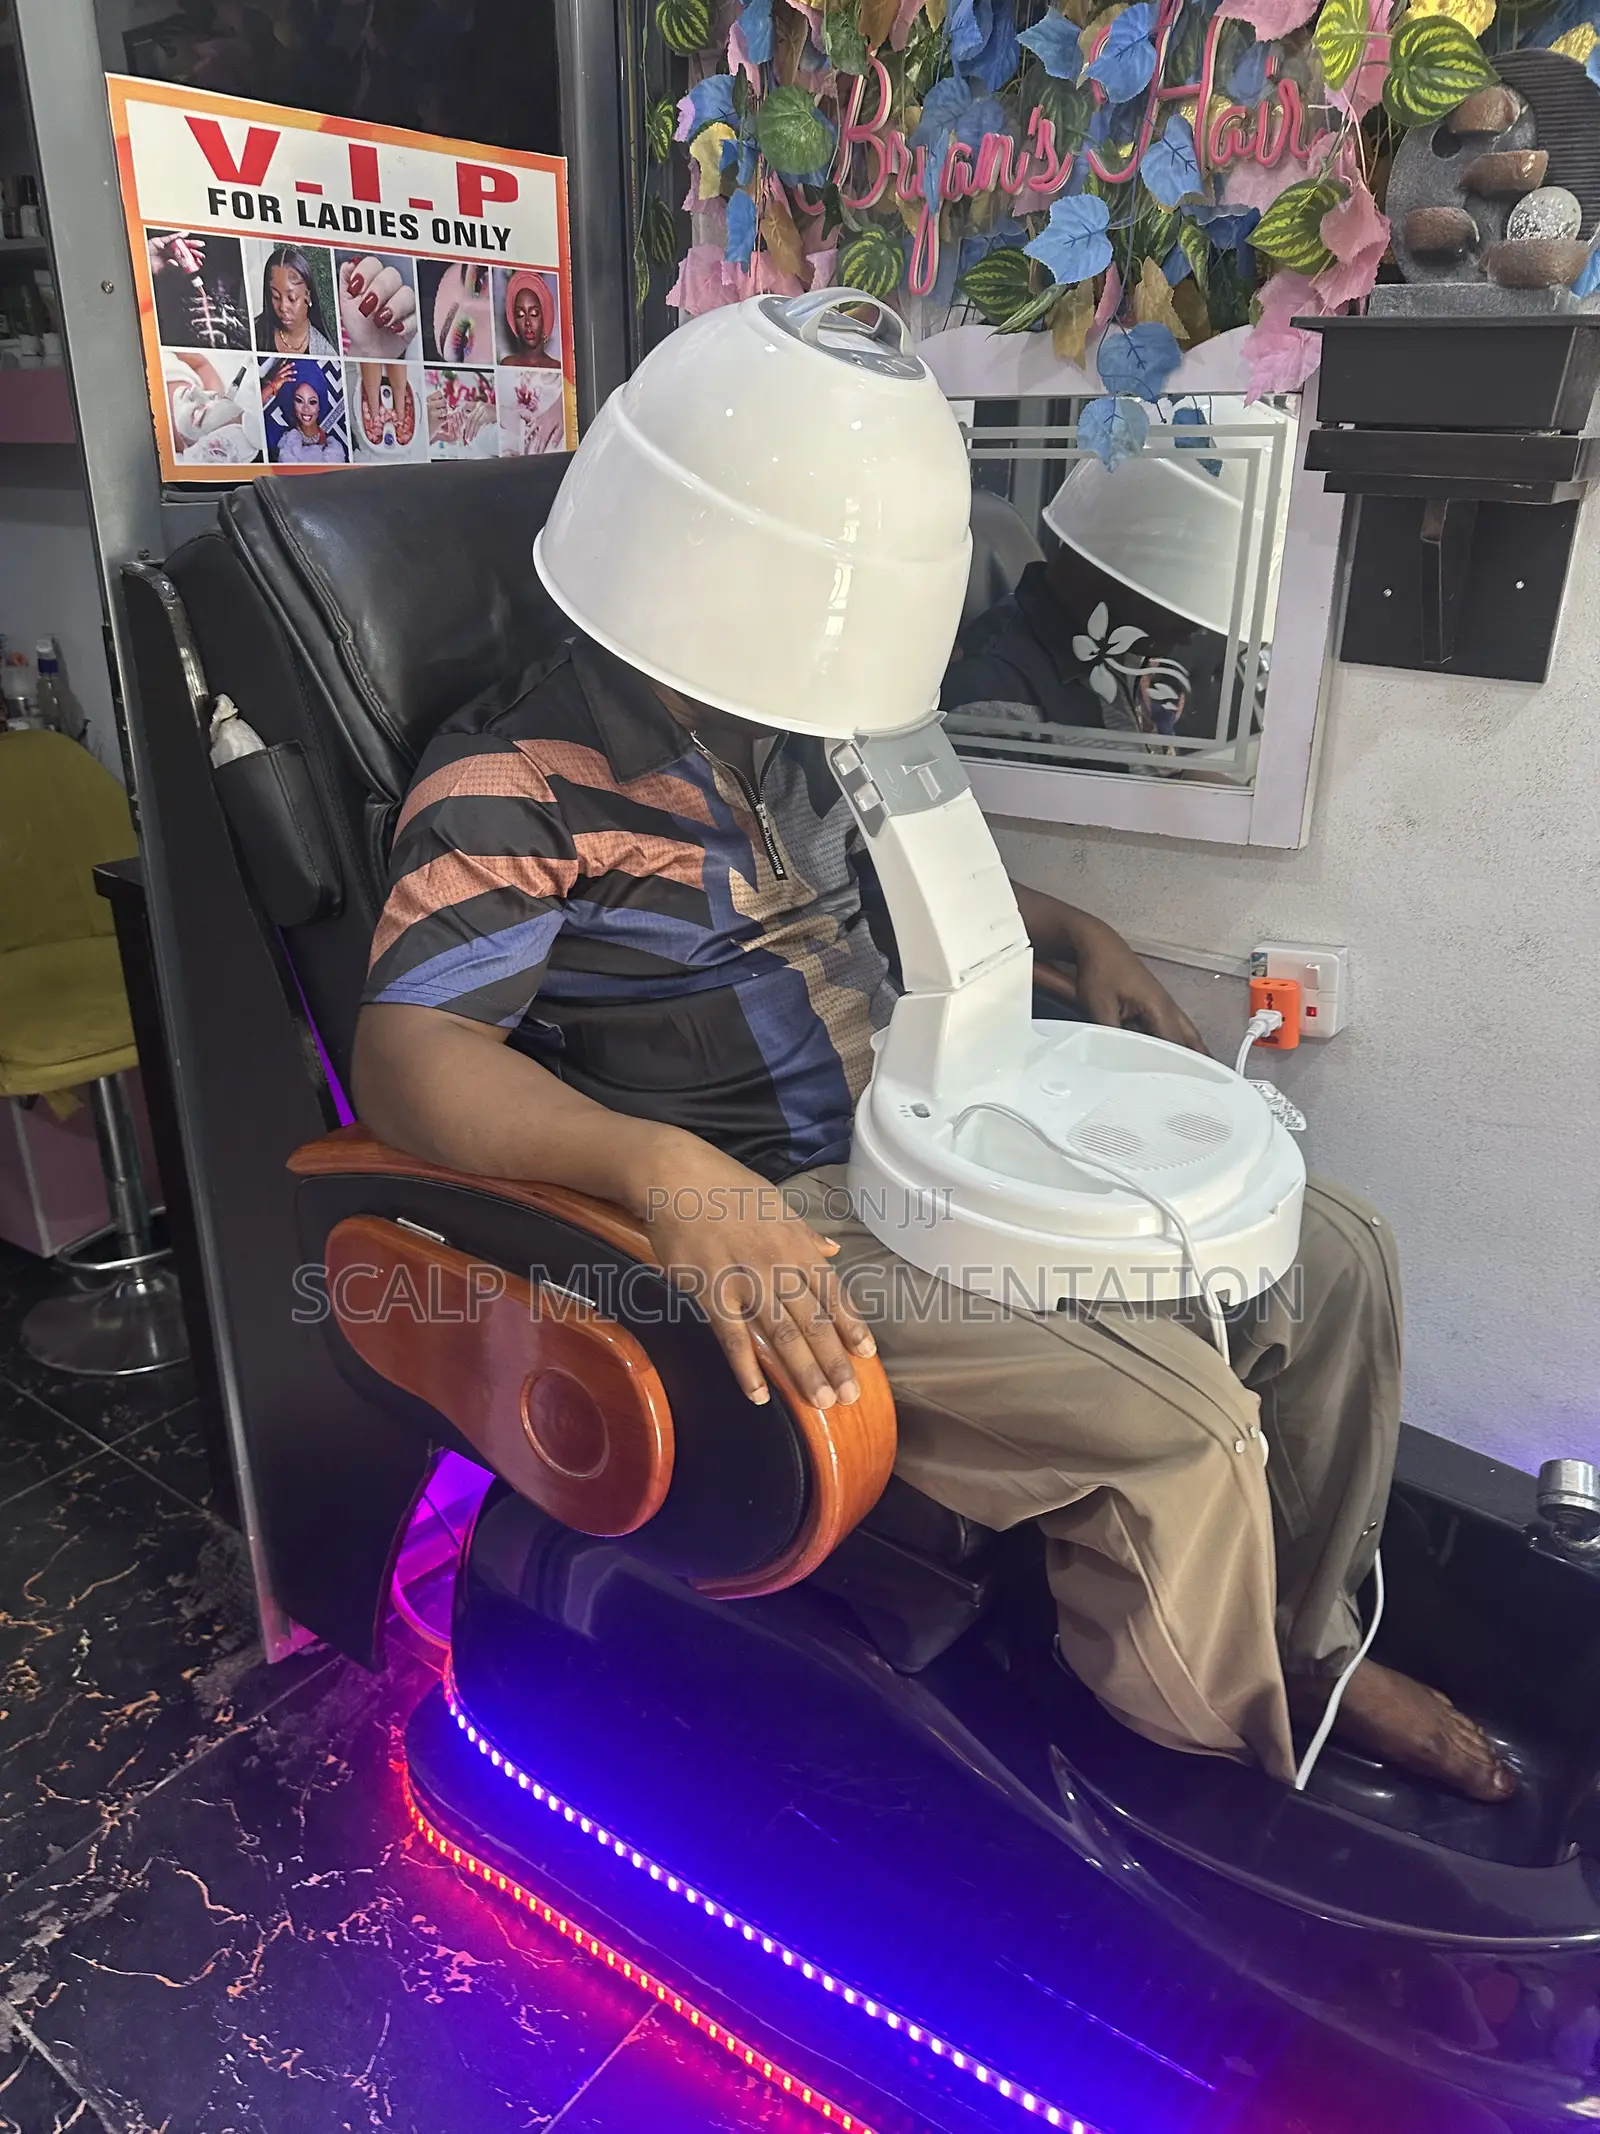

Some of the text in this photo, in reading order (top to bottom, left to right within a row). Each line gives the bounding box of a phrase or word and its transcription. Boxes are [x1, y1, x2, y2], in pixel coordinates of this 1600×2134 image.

[207, 187, 512, 252] FOR LADIES ONLY
